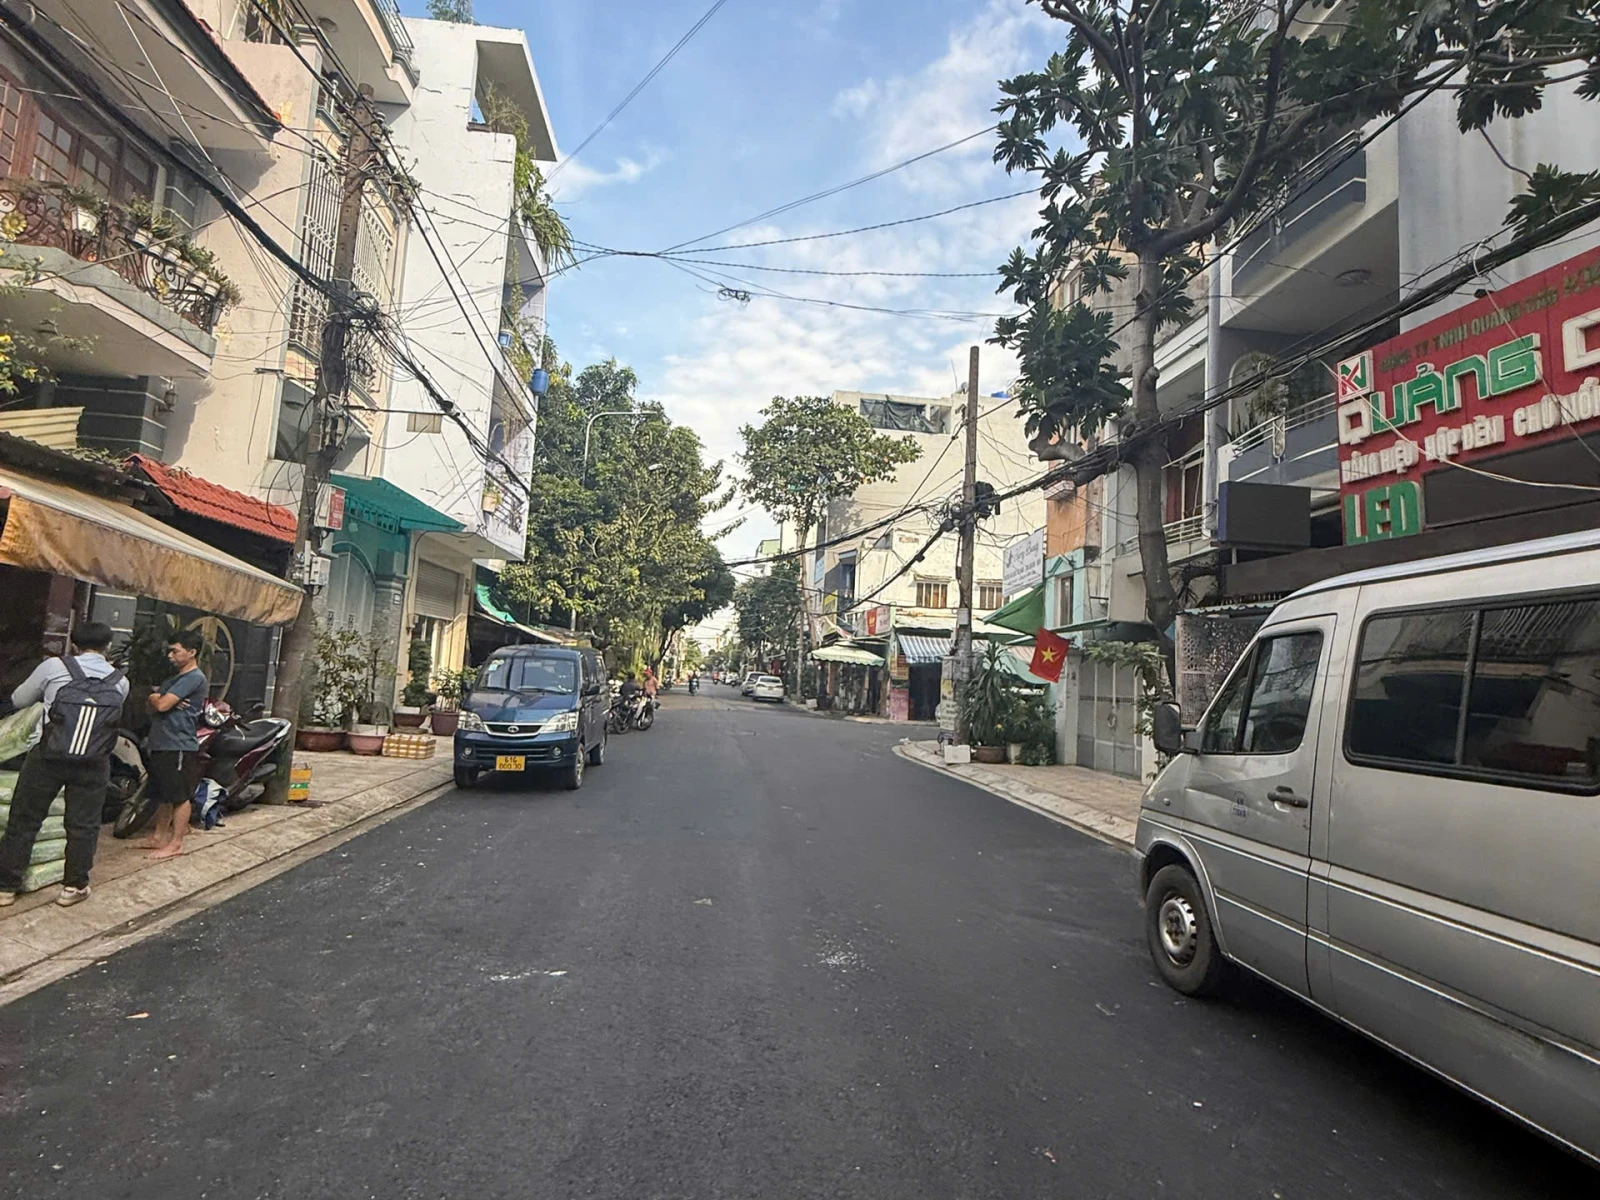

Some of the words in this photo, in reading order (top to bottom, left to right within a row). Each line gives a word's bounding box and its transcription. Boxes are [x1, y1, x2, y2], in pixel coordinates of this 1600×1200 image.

[1379, 440, 1418, 474] HIỆU
[1424, 426, 1461, 462] HỘP
[1461, 415, 1505, 451] ĐÈN
[1513, 394, 1562, 437] CHỮ
[1344, 480, 1423, 545] LED
